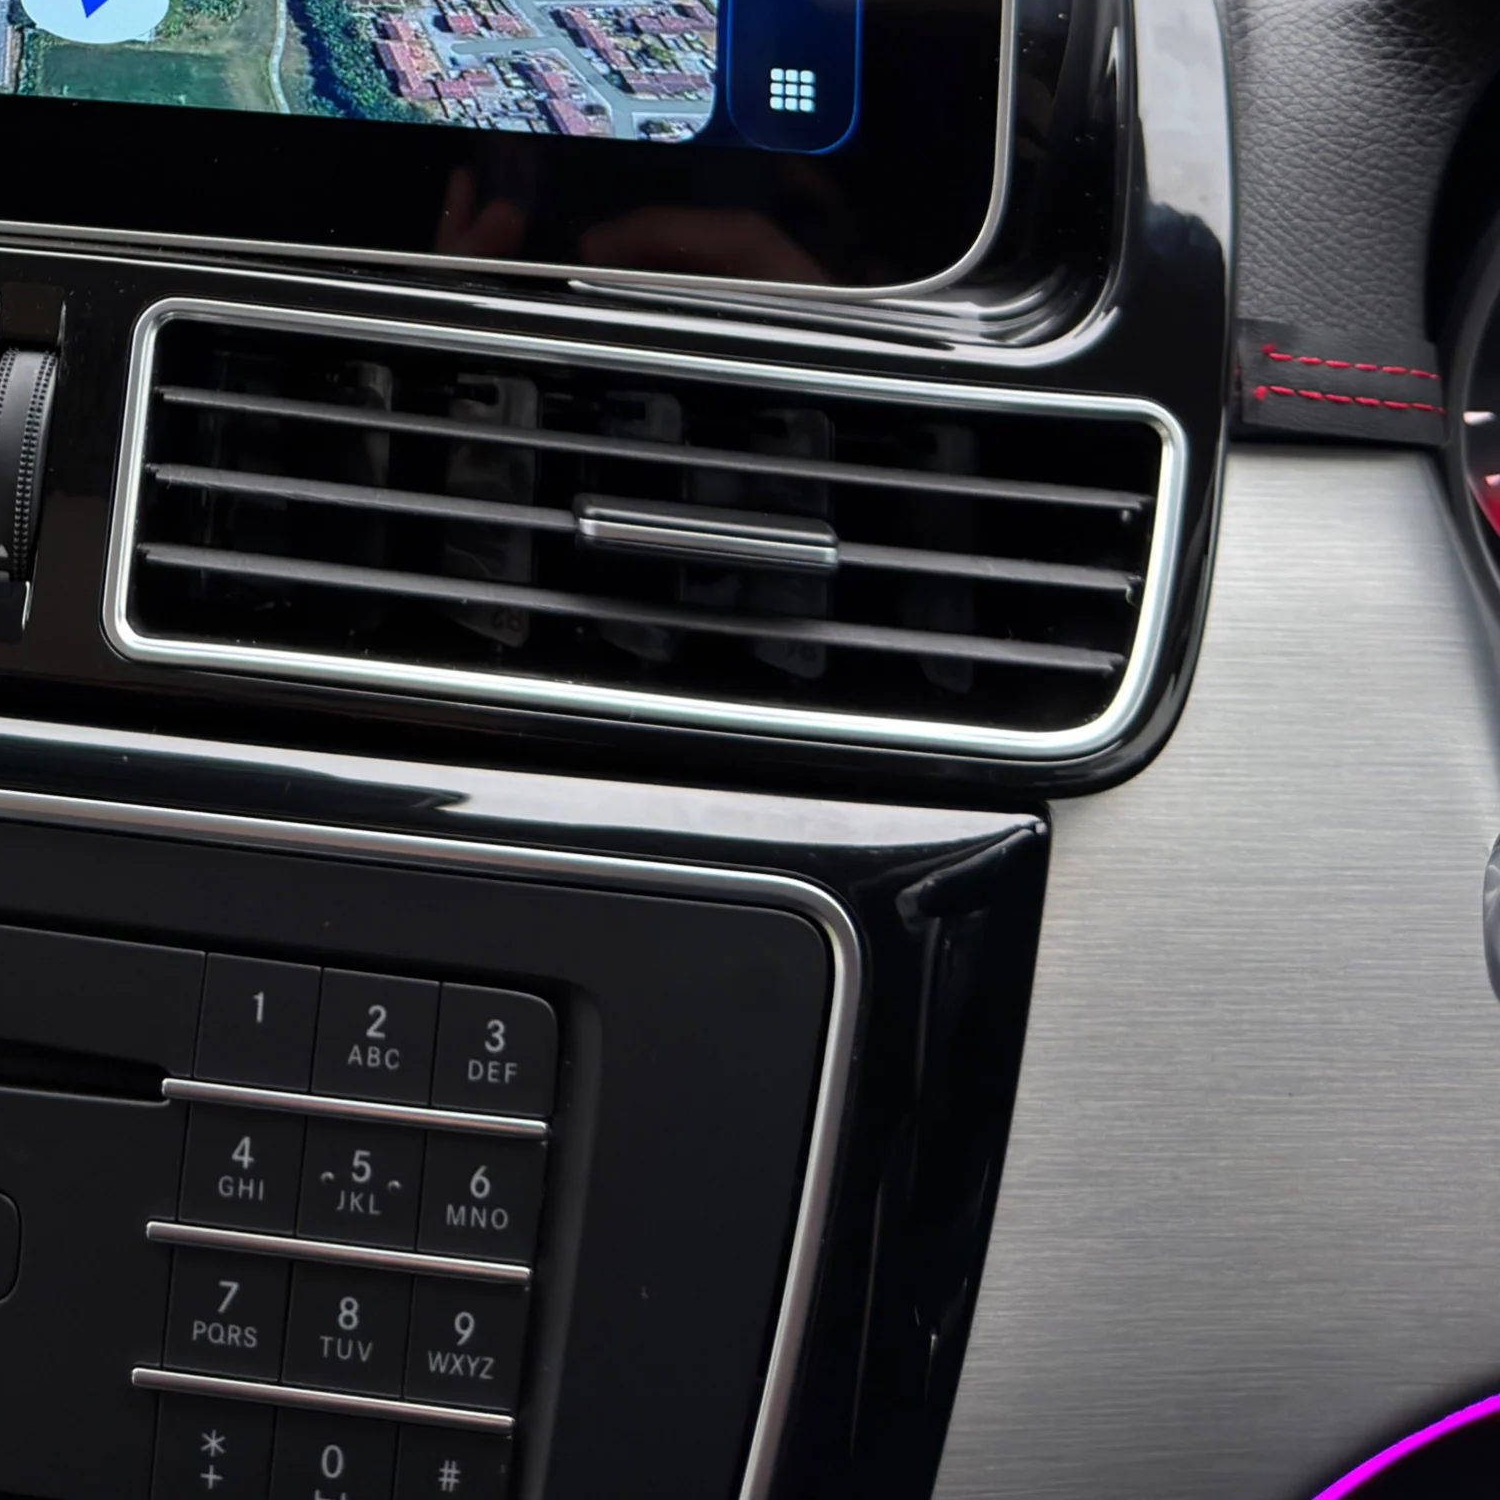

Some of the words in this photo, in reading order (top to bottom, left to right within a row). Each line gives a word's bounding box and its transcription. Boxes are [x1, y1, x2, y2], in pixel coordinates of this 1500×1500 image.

[253, 992, 265, 1023] 1
[366, 1005, 388, 1039] 2
[484, 1019, 506, 1053] 3
[347, 1045, 400, 1070] ABC
[468, 1059, 518, 1084] DEF
[231, 1136, 254, 1169] 4
[351, 1150, 372, 1183] 5
[218, 1175, 265, 1201] GHI
[470, 1165, 491, 1199] 6
[337, 1191, 382, 1216] JKL
[446, 1204, 509, 1230] MNO
[218, 1281, 239, 1313] 7
[338, 1297, 359, 1330] 8
[454, 1311, 475, 1345] 9
[192, 1320, 258, 1349] PQRS
[320, 1336, 374, 1362] TUV
[428, 1351, 495, 1380] WXYZ
[321, 1444, 343, 1478] 0
